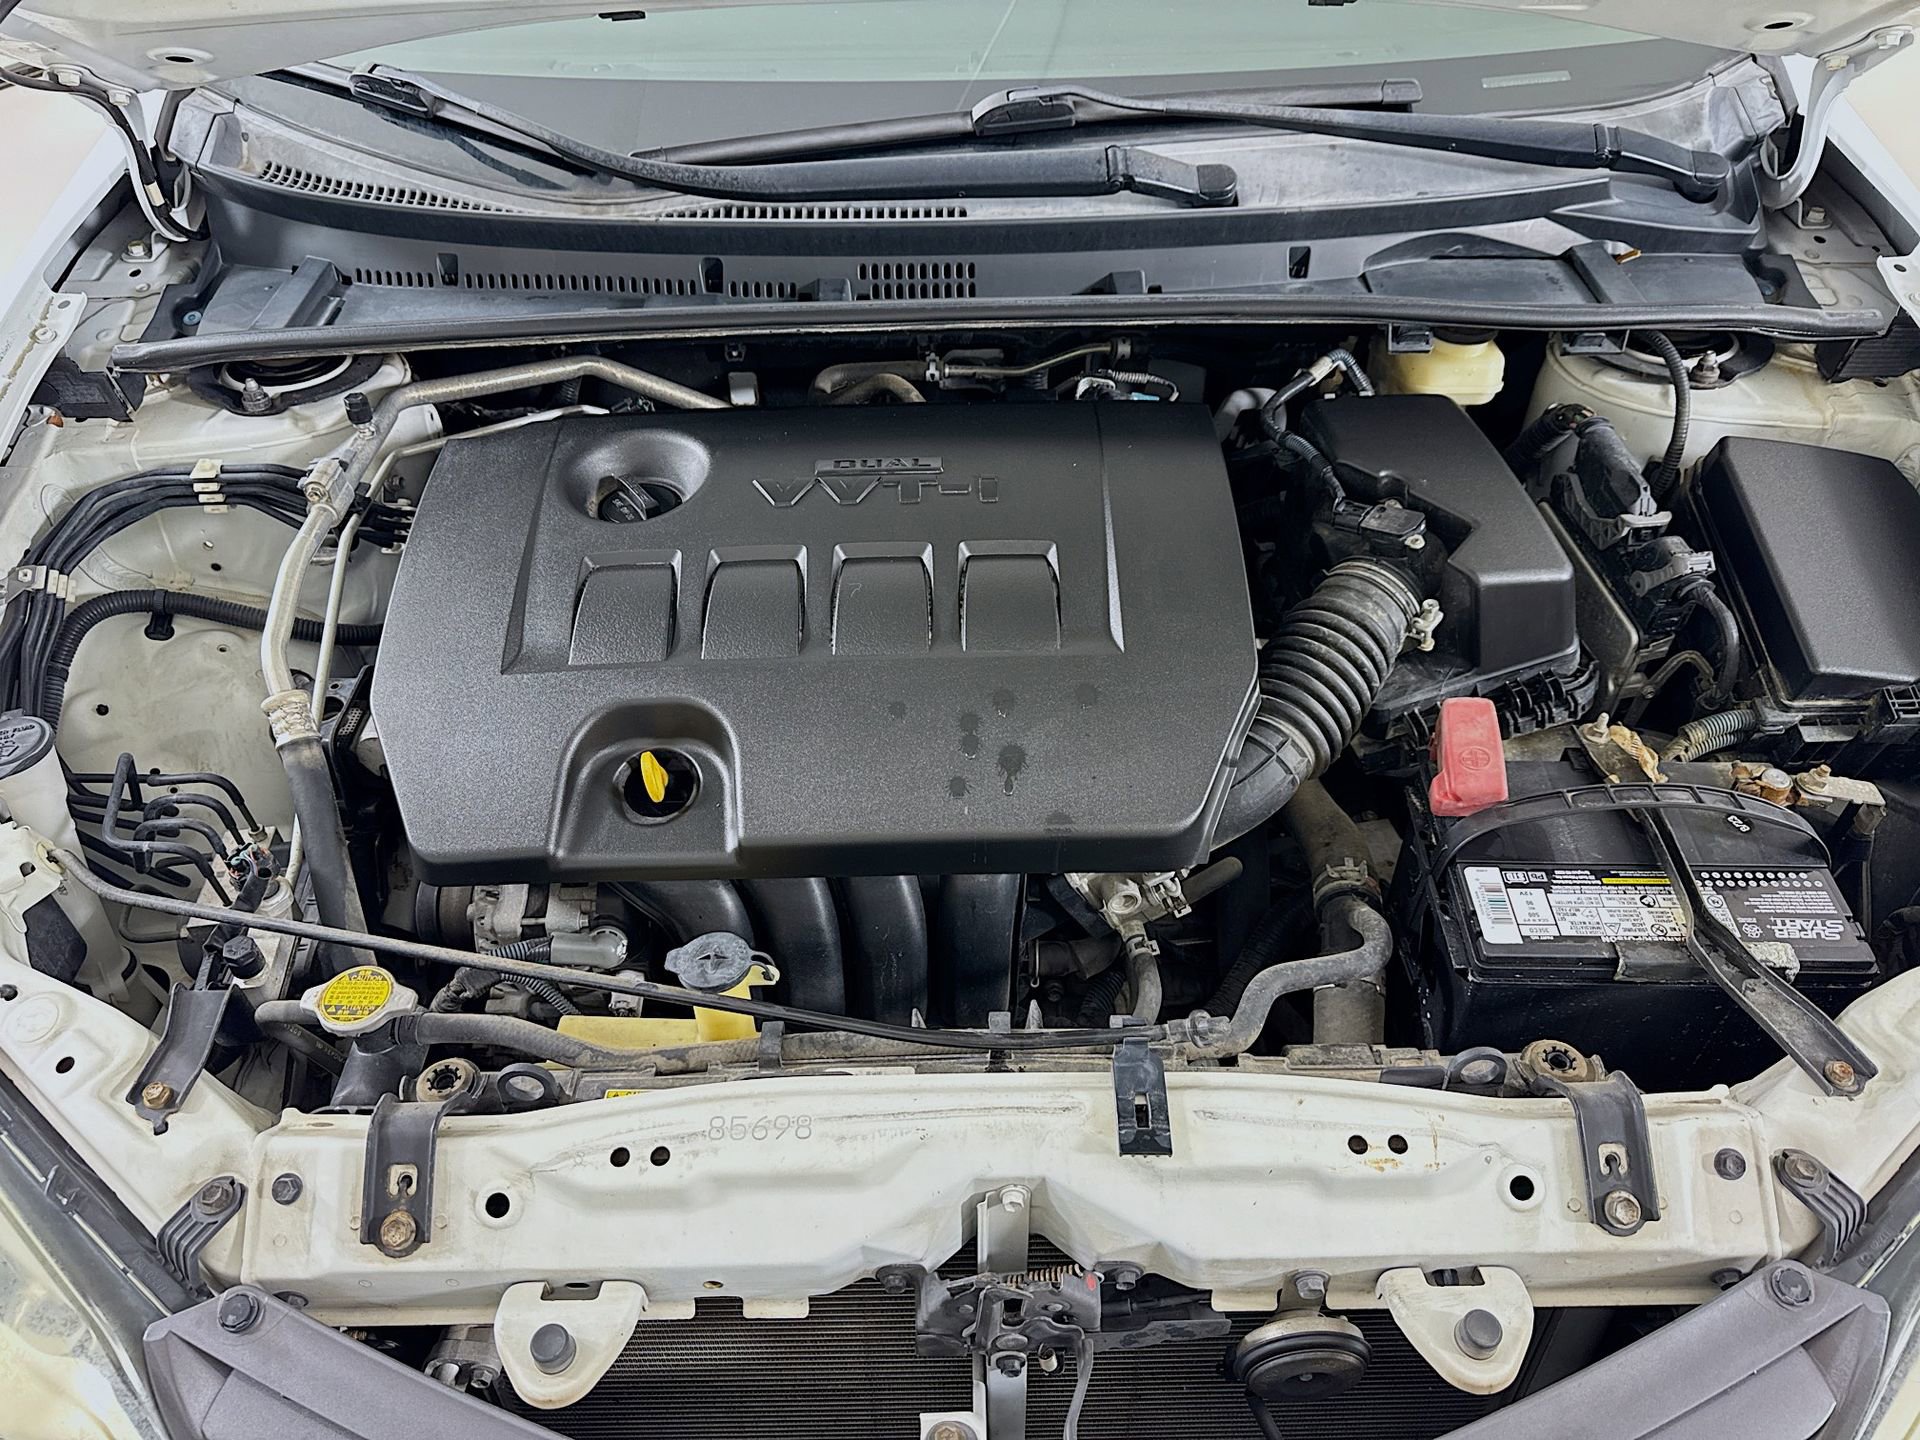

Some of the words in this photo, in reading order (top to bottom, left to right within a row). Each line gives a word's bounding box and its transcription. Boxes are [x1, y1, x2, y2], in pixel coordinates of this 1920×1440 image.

[833, 457, 932, 470] DUAL
[1771, 917, 1845, 932] START
[1774, 928, 1841, 940] SUPER
[708, 1114, 812, 1141] 85698
